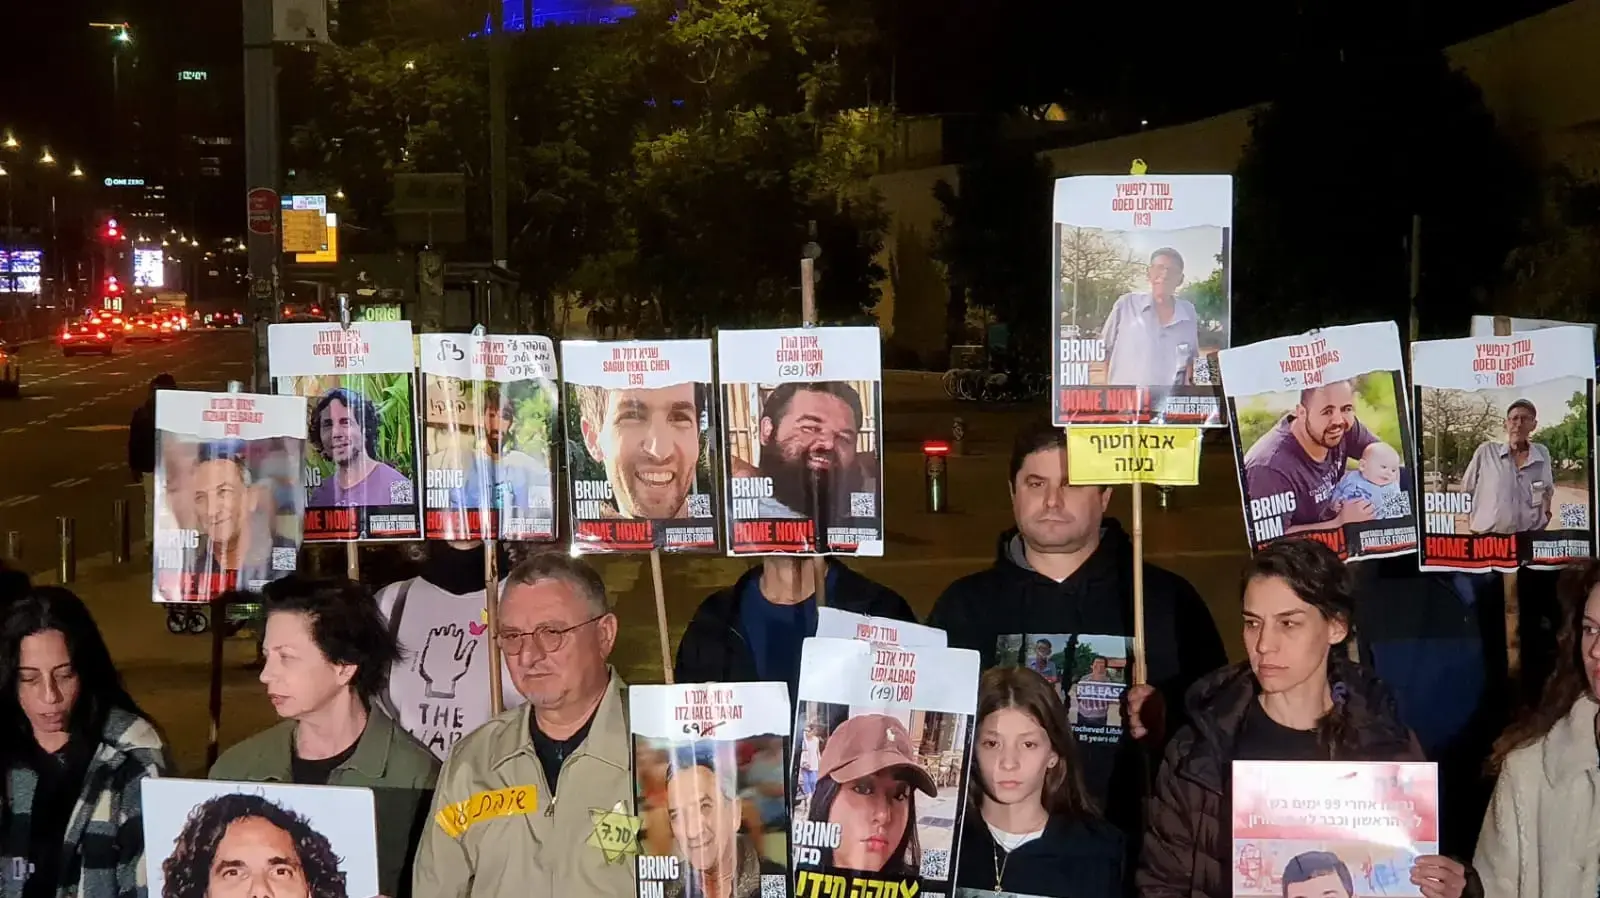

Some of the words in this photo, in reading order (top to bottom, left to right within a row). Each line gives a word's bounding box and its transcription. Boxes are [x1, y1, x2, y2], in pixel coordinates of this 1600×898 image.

[113, 178, 127, 186] ONE
[1116, 182, 1147, 198] ליפשיץ
[1150, 182, 1170, 196] עודד
[1112, 198, 1134, 211] ODED
[1136, 197, 1174, 211] LIFSHITZ
[1134, 211, 1151, 227] (83)
[313, 344, 331, 356] OFER
[780, 336, 798, 350] הורן
[800, 336, 818, 349] איתן
[1060, 339, 1106, 362] BRING
[1289, 344, 1310, 358] ביבס
[1311, 338, 1326, 356] ירדן
[1476, 343, 1510, 358] ליפשיץ
[1512, 338, 1531, 356] עודד
[776, 349, 800, 362] EITAN
[801, 349, 823, 362] HORN
[1279, 357, 1314, 373] YARDEN
[1315, 350, 1340, 369] BIBAS
[1473, 358, 1497, 372] ODED
[1498, 353, 1535, 371] LIFSHITZ
[603, 360, 625, 372] SAGUI
[626, 360, 649, 372] DEKEL
[650, 359, 671, 371] CHEN
[778, 363, 804, 377] (38)
[1060, 361, 1089, 386] HIM
[628, 373, 644, 385] (35)
[1304, 370, 1322, 386] (34)
[1496, 371, 1514, 387] (83)
[1060, 388, 1103, 412] HOME
[1090, 434, 1133, 452] חטוף
[1139, 434, 1175, 450] אבא
[1115, 456, 1155, 474] בעזה
[426, 469, 464, 489] BRING
[731, 477, 773, 498] BRING
[426, 488, 451, 508] HIM
[575, 480, 614, 500] BRING
[577, 499, 601, 519] HIM
[733, 497, 760, 519] HIM
[1250, 491, 1296, 521] BRING
[1424, 492, 1472, 514] BRING
[324, 507, 357, 532] NOW!
[1425, 513, 1456, 535] HIM
[616, 520, 653, 542] NOW!
[732, 521, 772, 544] HOME
[775, 519, 814, 543] NOW!
[1254, 516, 1284, 542] HIM
[1361, 536, 1391, 550] FAMILIES
[1392, 533, 1417, 546] FORUM
[1426, 537, 1469, 558] HOME
[1473, 535, 1517, 559] NOW!
[1533, 548, 1564, 560] FAMILIES
[879, 626, 898, 642] עודד
[876, 650, 898, 666] אלבג
[899, 651, 916, 667] לירי
[871, 667, 888, 682] LIRI
[888, 669, 916, 685] ALBAG
[870, 685, 895, 702] (19)
[418, 703, 465, 728] THE
[682, 722, 700, 734] 69
[420, 730, 462, 752] AR
[1292, 799, 1320, 811] ימים
[1324, 798, 1341, 810] 99
[1352, 815, 1399, 829] הראשון
[601, 822, 631, 844] 7.10
[791, 820, 841, 849] BRING
[638, 855, 680, 881] BRING
[640, 881, 665, 898] HIM
